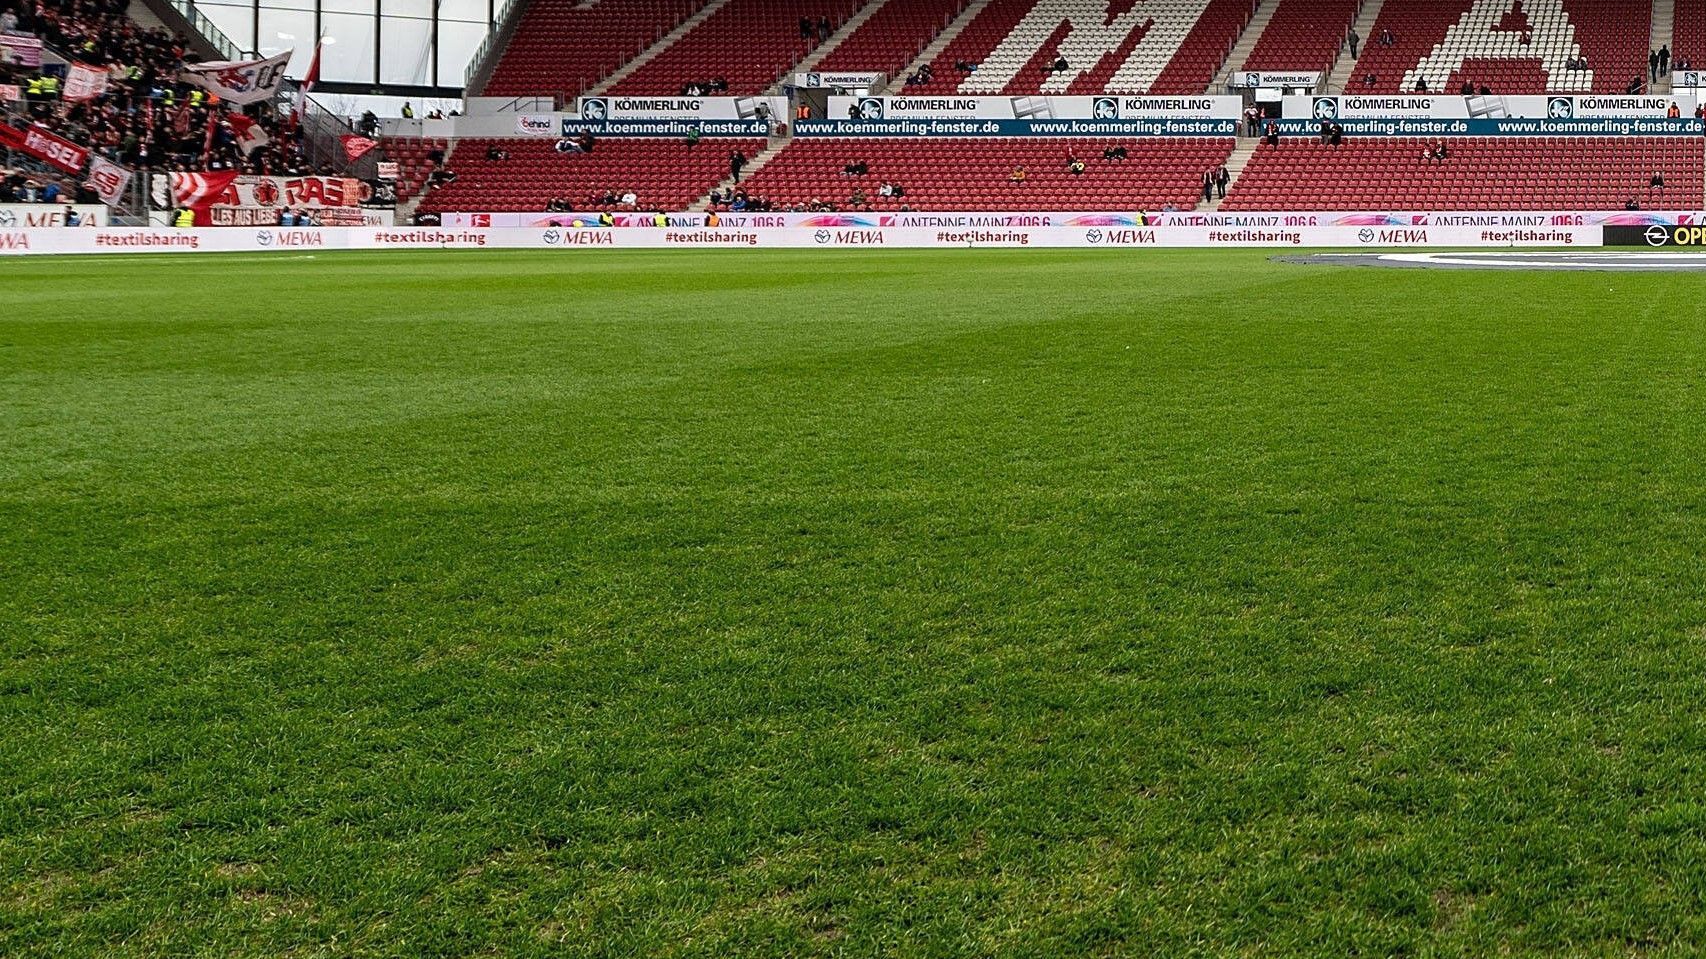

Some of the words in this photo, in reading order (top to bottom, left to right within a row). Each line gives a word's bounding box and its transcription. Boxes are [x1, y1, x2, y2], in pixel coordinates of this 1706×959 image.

[614, 98, 700, 110] KÖMMERLING
[890, 97, 976, 110] KÖMMERLING
[1126, 97, 1210, 110] KÖMMERLING
[1344, 96, 1430, 110] KÖMMERLING
[1580, 96, 1665, 110] KÖMMERLING
[796, 120, 1000, 135] www.koemmerling-fenster.de
[1030, 120, 1234, 135] www.koemmerling-fenster.de
[1263, 120, 1468, 134] ww.komerling-fenster.de
[1498, 120, 1702, 134] www.koemmerling-fenster.de
[26, 212, 97, 227] MEA
[718, 216, 746, 226] AINZ
[96, 232, 198, 248] #textilsharing
[276, 232, 322, 245] MEWA
[375, 232, 485, 245] #textilsharing
[564, 232, 612, 244] MEWA
[665, 231, 757, 244] #textilsharing
[834, 231, 884, 244] MEWA
[1106, 231, 1155, 243] MEWA
[1209, 231, 1300, 244] #textilsharing
[1378, 230, 1428, 243] MEWA
